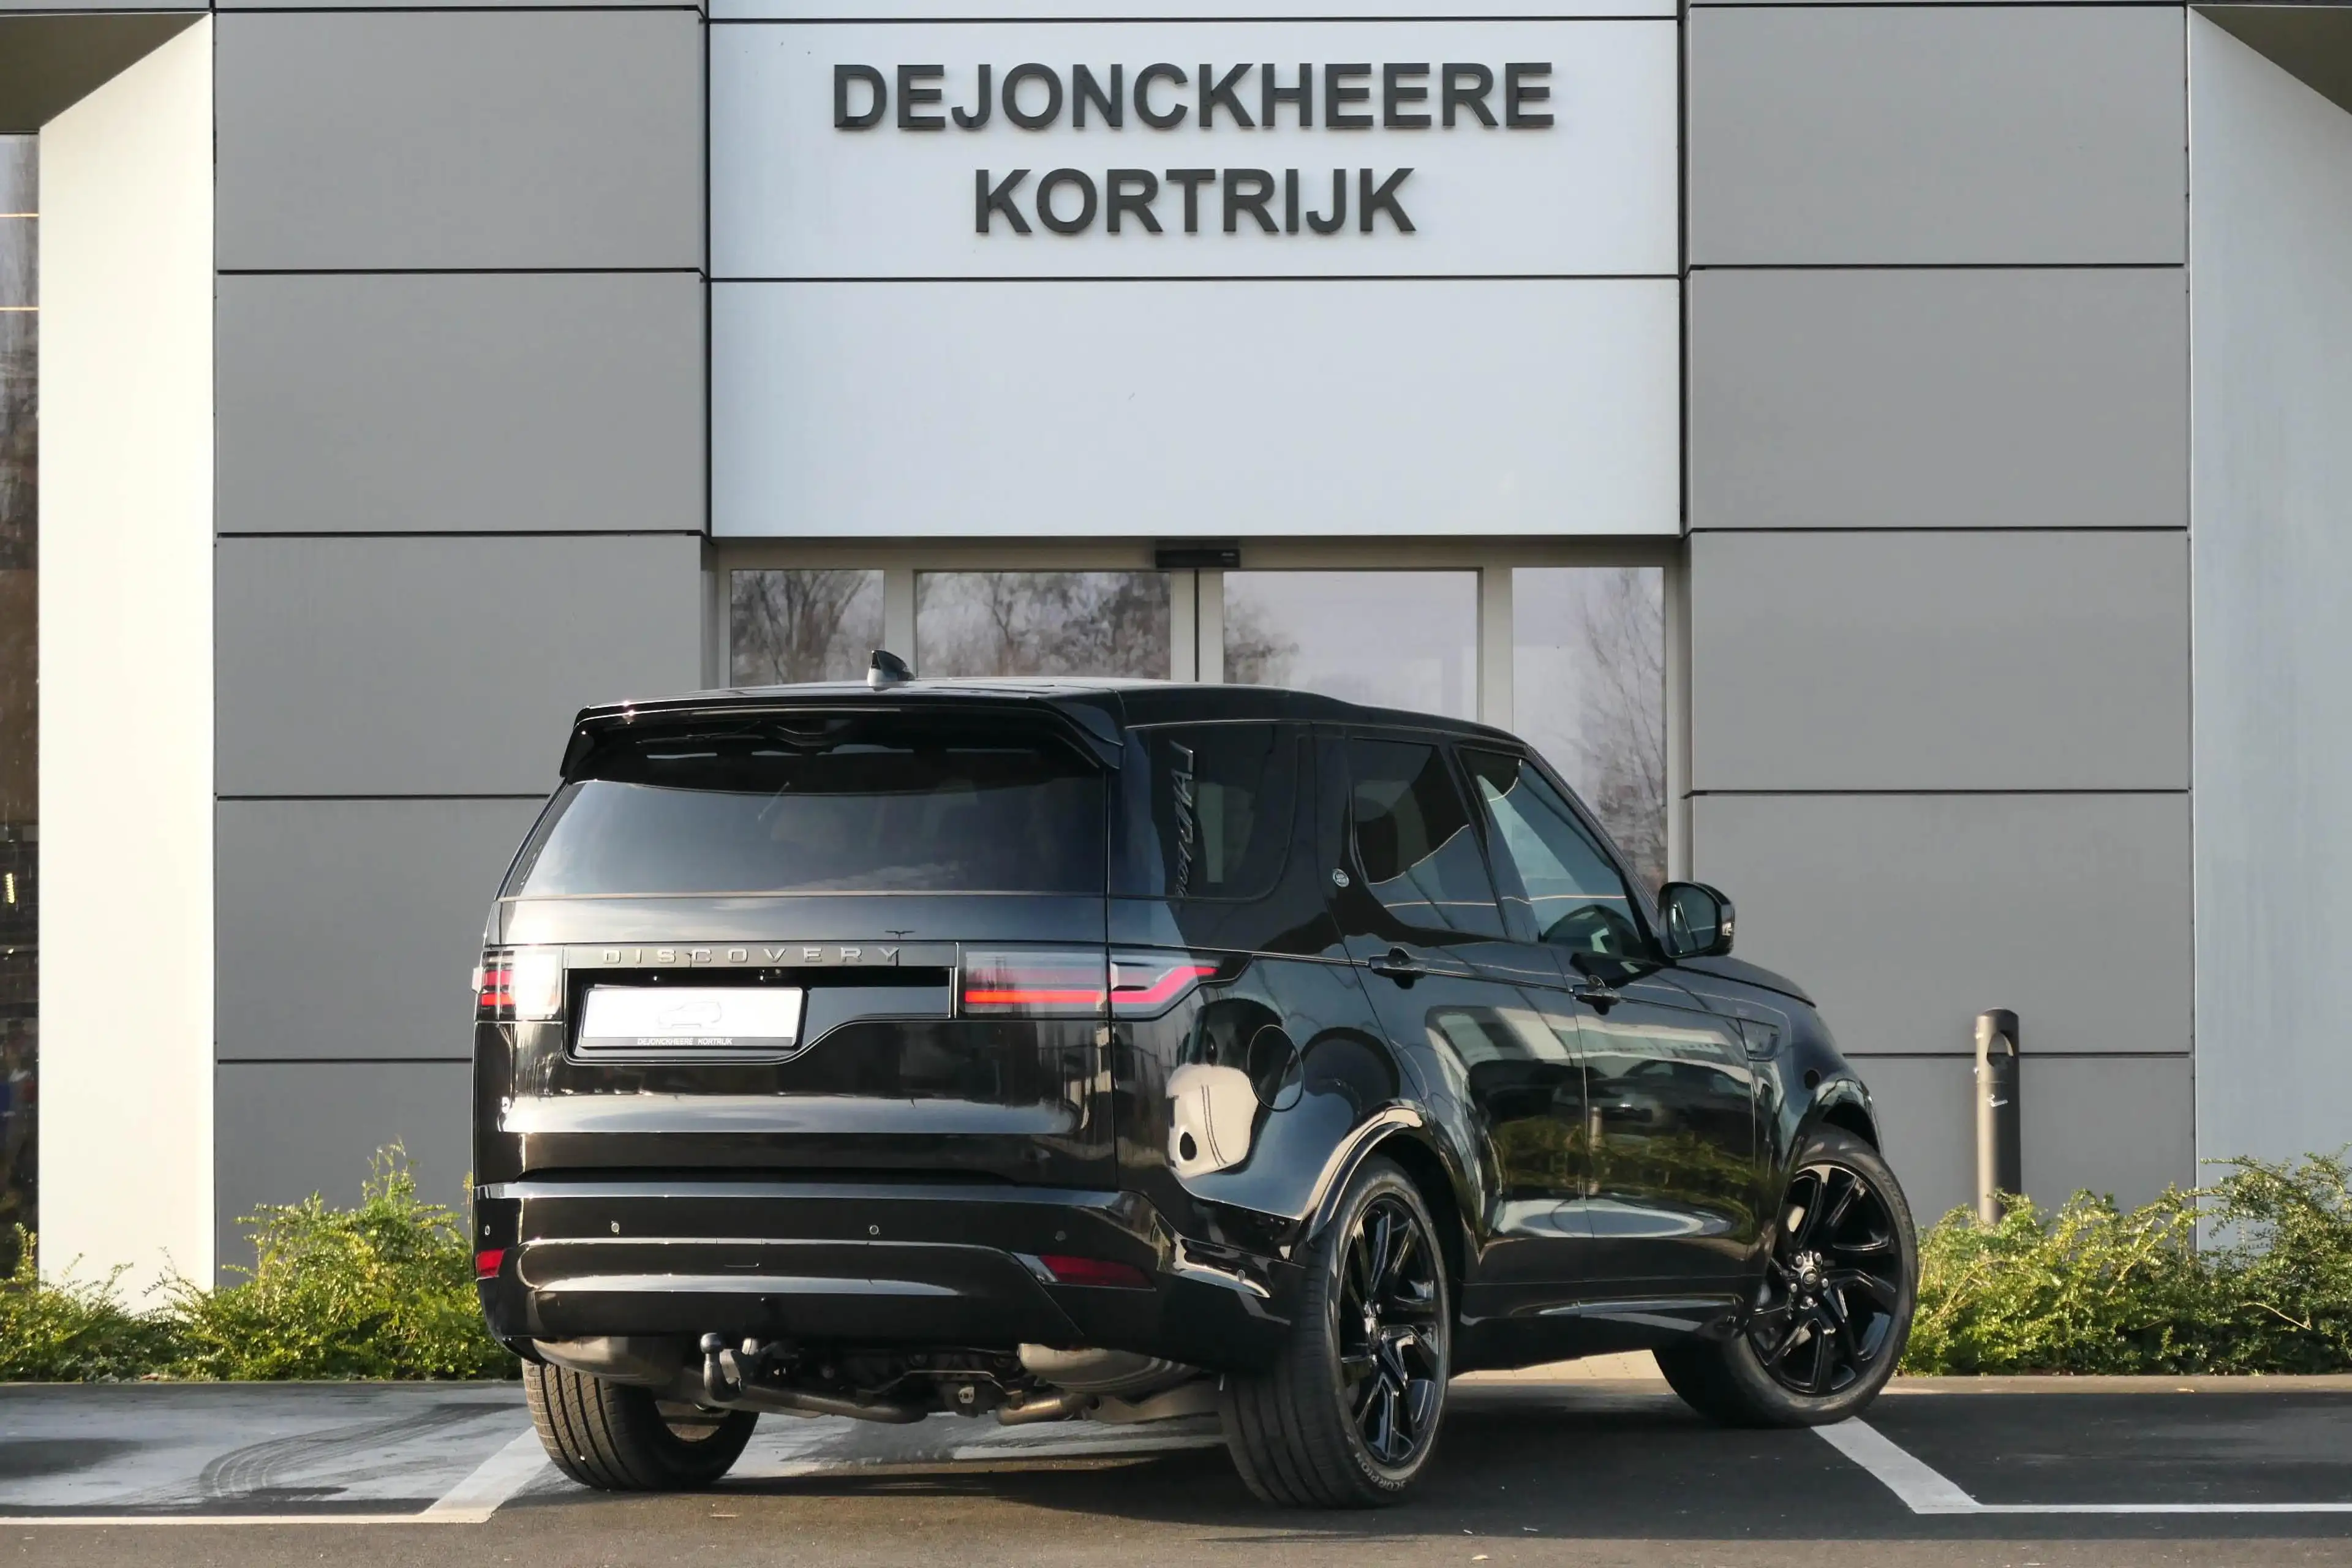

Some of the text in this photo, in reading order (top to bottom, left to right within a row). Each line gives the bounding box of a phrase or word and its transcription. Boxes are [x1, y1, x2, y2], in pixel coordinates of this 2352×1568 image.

[833, 62, 1555, 130] DEJONCKHEERE
[974, 167, 1416, 235] KORTRIJK
[603, 946, 900, 963] DISCOVERY
[637, 1037, 733, 1046] DEJONCKHEERE KORTRIJK
